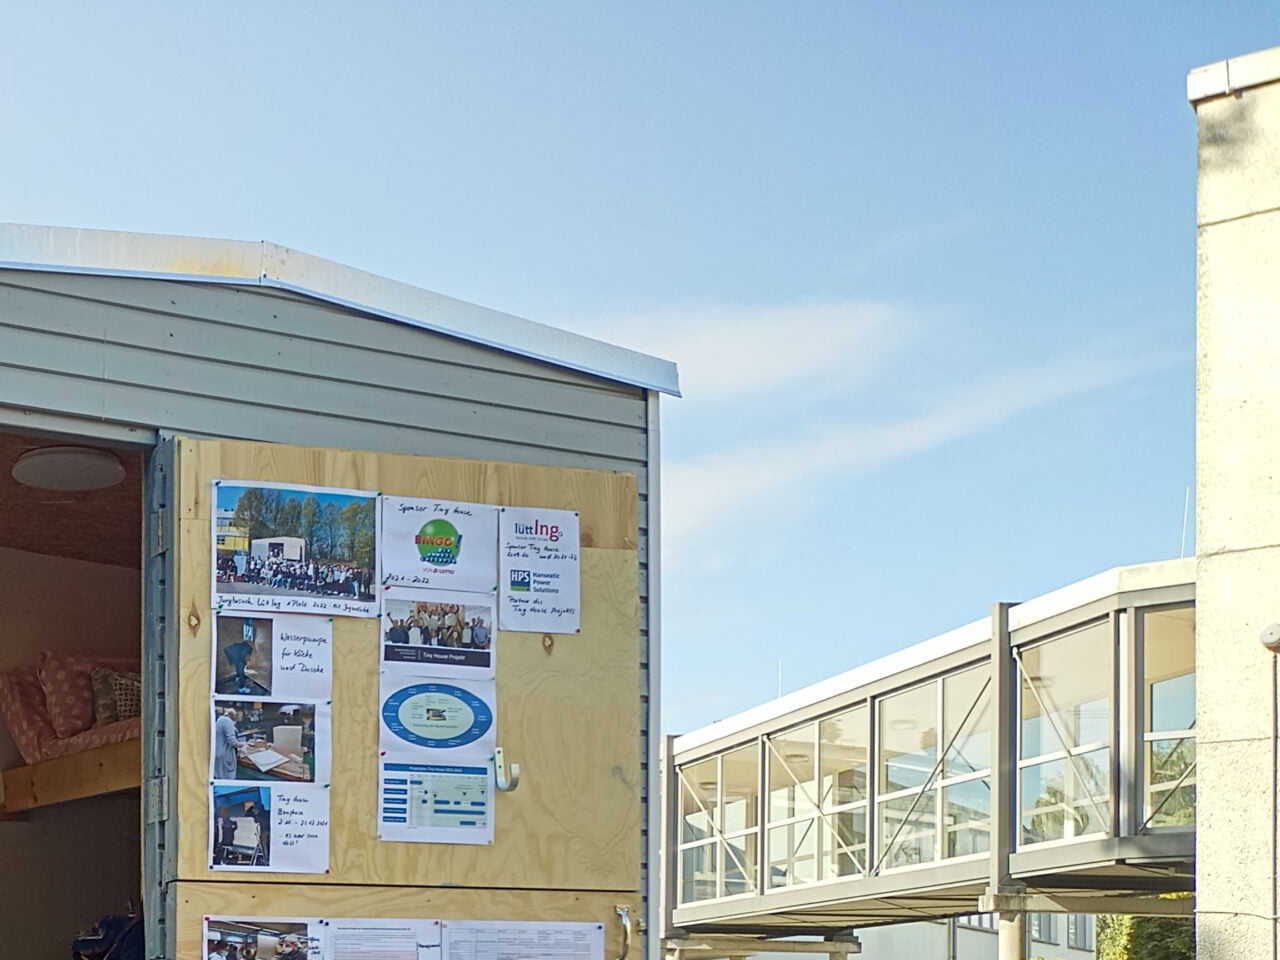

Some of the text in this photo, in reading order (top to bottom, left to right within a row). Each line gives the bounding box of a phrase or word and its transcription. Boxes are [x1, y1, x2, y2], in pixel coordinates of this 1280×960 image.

[511, 571, 530, 583] HPS
[532, 571, 560, 579] Hanseatic
[532, 586, 559, 594] Solutions
[423, 652, 433, 660] Tiny
